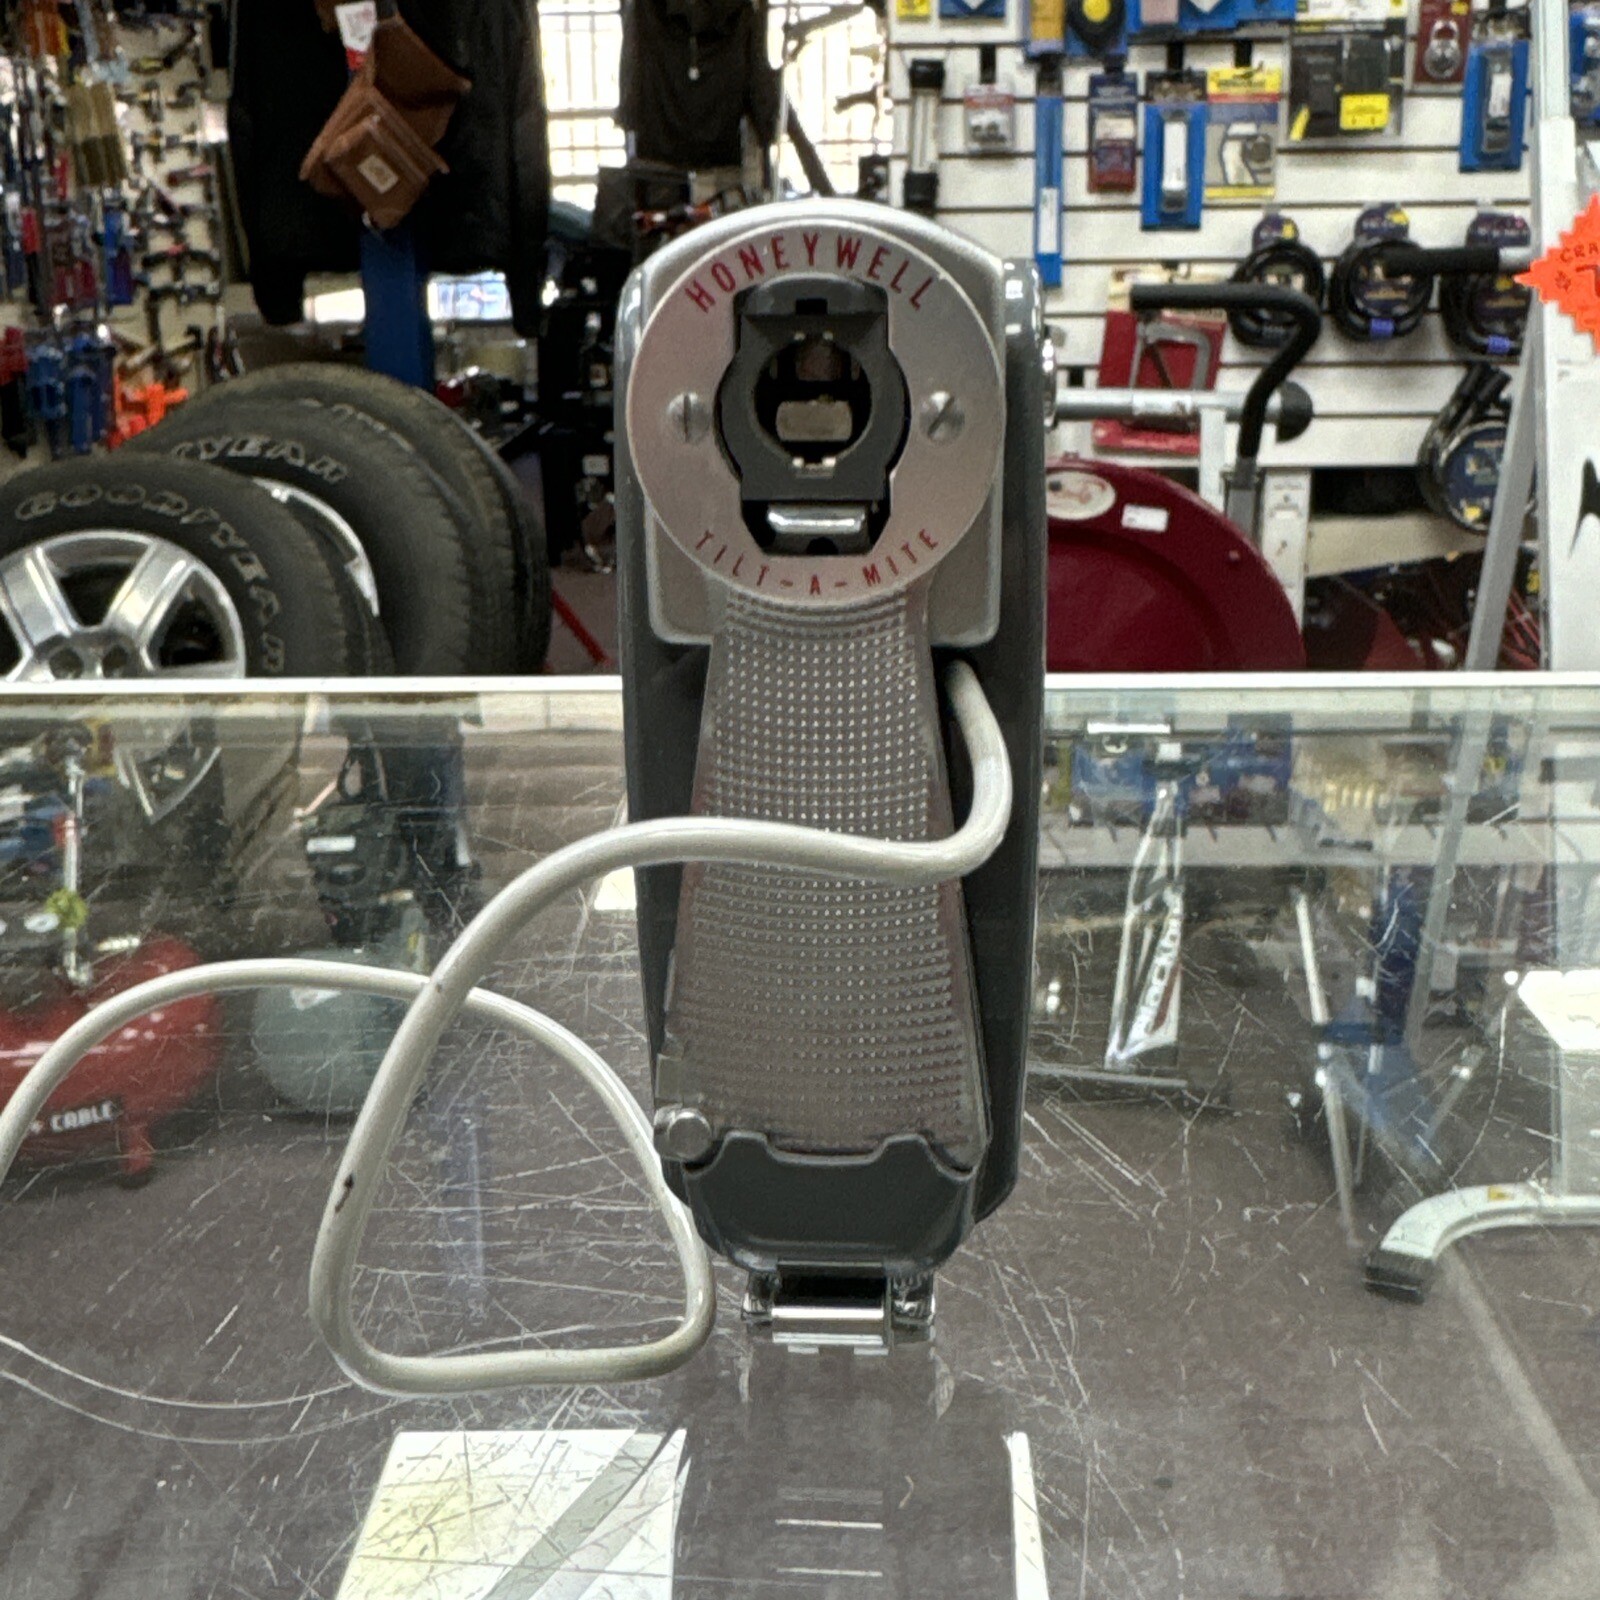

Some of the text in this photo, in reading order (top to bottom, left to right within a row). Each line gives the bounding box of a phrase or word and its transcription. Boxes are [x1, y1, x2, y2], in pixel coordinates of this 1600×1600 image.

[685, 232, 935, 313] HONEYWELL
[15, 484, 285, 672] GOODYEAR
[695, 528, 940, 596] TILT-A-MITE
